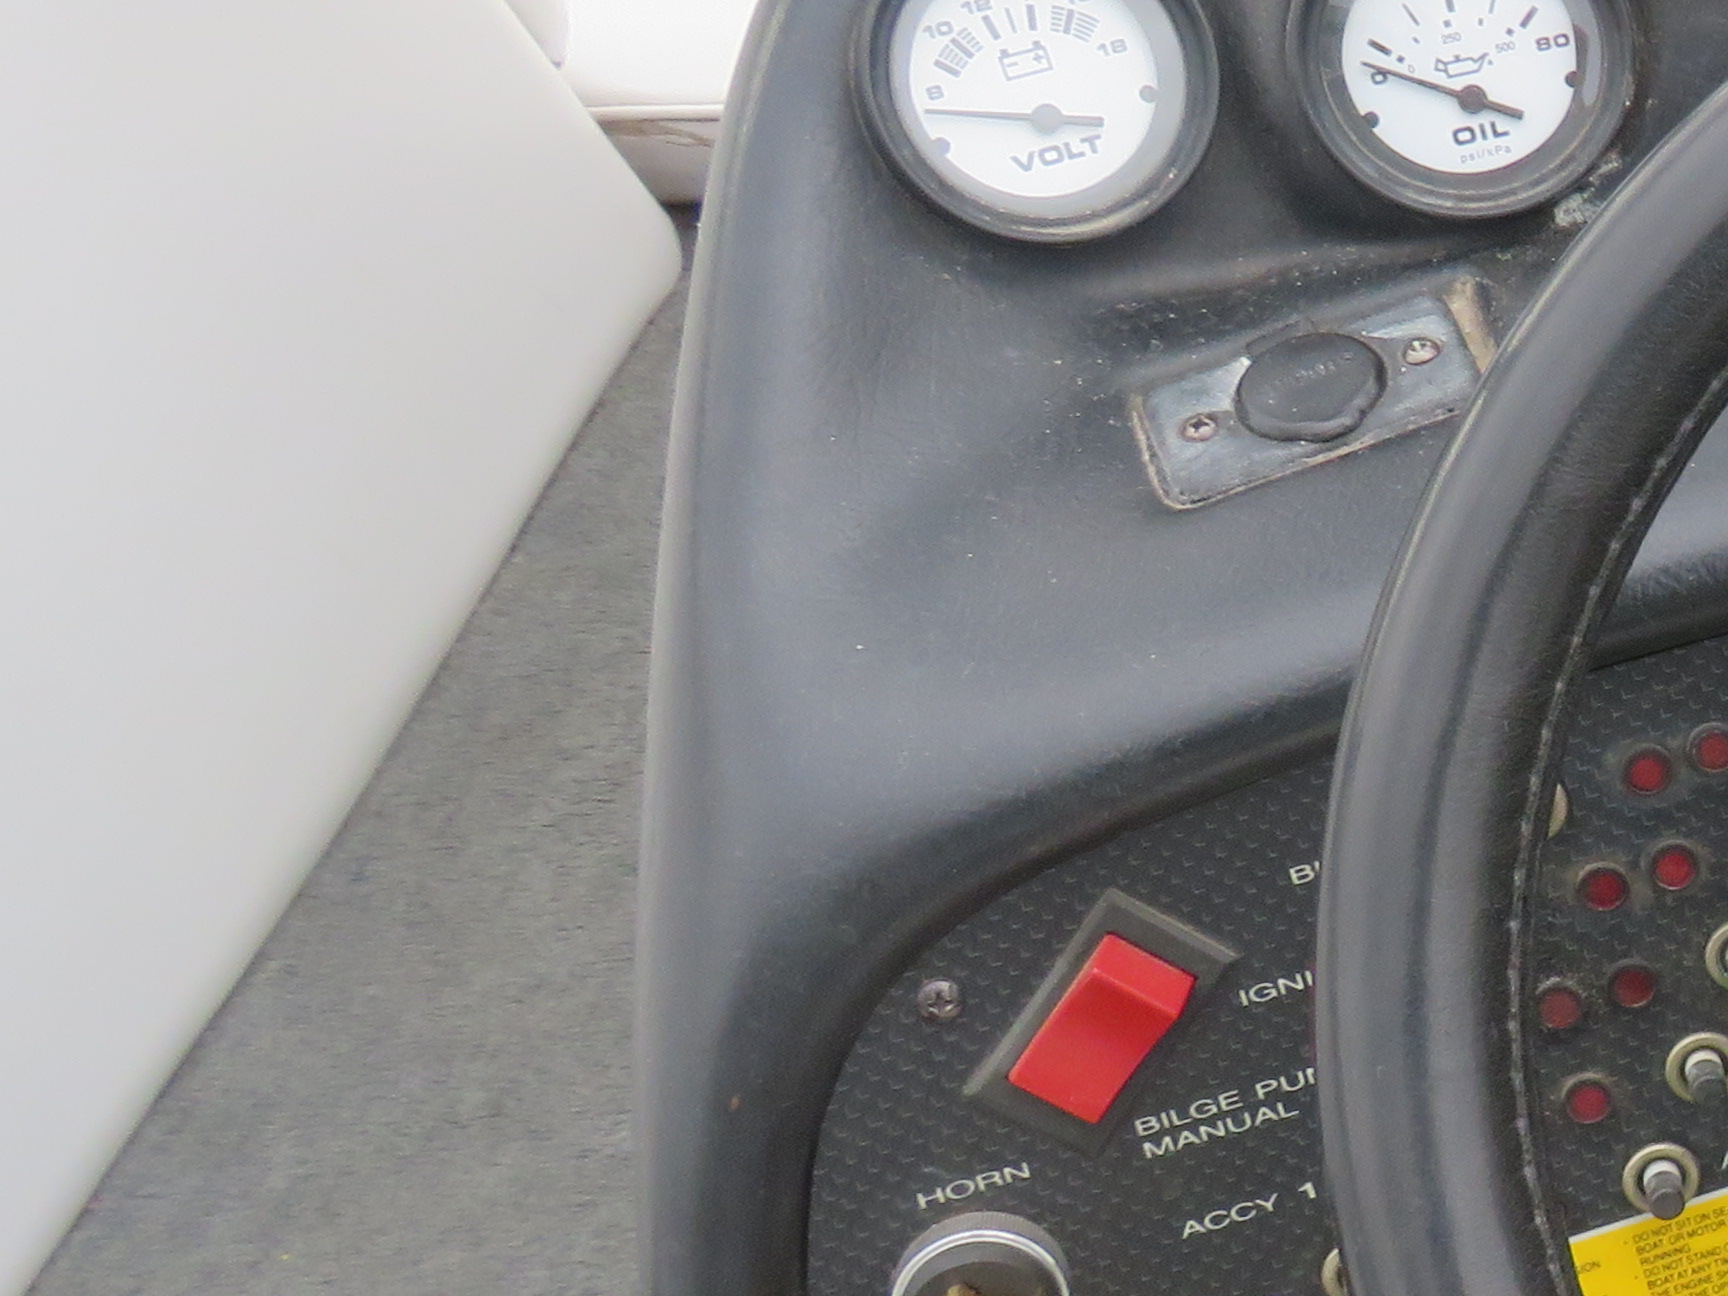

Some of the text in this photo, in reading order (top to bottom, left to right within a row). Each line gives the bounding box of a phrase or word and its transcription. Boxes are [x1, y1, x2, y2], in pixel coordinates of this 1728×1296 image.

[923, 20, 954, 38] 10
[1096, 38, 1128, 56] 18
[1535, 32, 1570, 52] 80
[1370, 70, 1388, 86] 0
[1451, 120, 1511, 147] OIL
[1010, 134, 1103, 174] VOLT
[1239, 969, 1314, 1008] IGNI
[1135, 1090, 1240, 1138] BILGE
[1143, 1103, 1300, 1159] MANUAL
[916, 1161, 1031, 1210] HORN
[1181, 1182, 1317, 1240] ACCY 1
